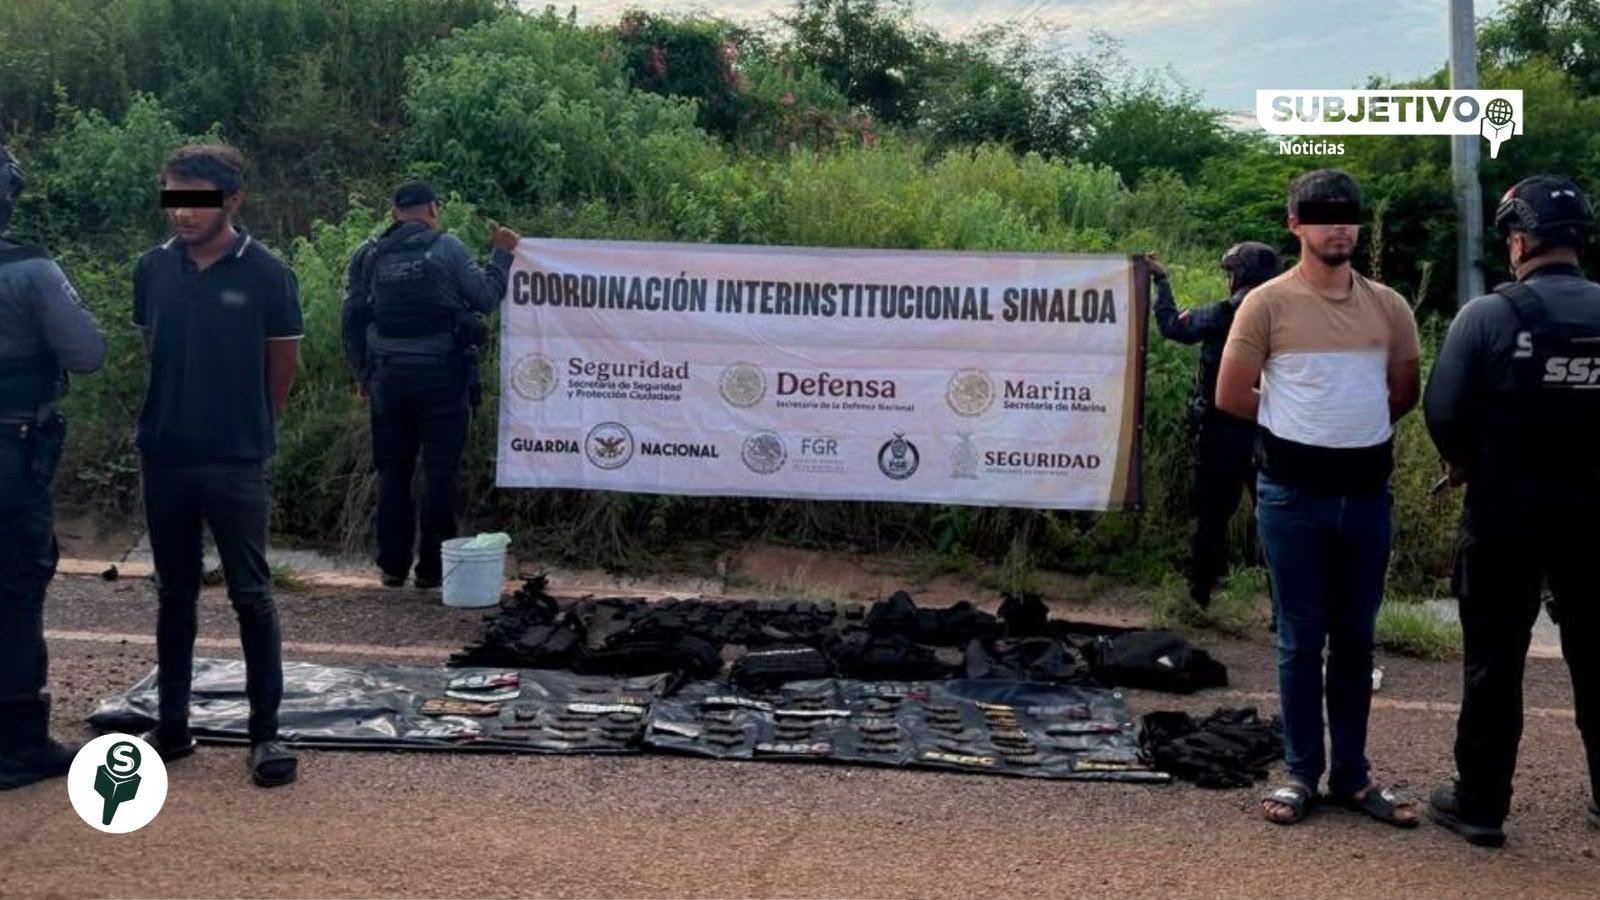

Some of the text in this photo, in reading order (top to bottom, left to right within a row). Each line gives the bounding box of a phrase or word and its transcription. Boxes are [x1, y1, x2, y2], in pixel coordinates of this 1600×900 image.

[512, 270, 1117, 324] COORDINACIÓN INTERINSTITUCIONAL SINALOA
[568, 357, 690, 381] Seguridad
[618, 381, 631, 390] de
[633, 381, 682, 392] Seguridad
[776, 372, 896, 399] Defensa
[1003, 380, 1092, 401] Marina
[566, 390, 574, 399] y
[629, 390, 681, 401] Ciudadana
[820, 401, 830, 409] de
[832, 401, 840, 409] la
[1055, 402, 1068, 411] de
[1071, 402, 1107, 413] Marina
[511, 438, 719, 458] GUARDIA NACIONAL
[801, 438, 838, 456] FGR
[984, 450, 1101, 469] SEGURIDAD
